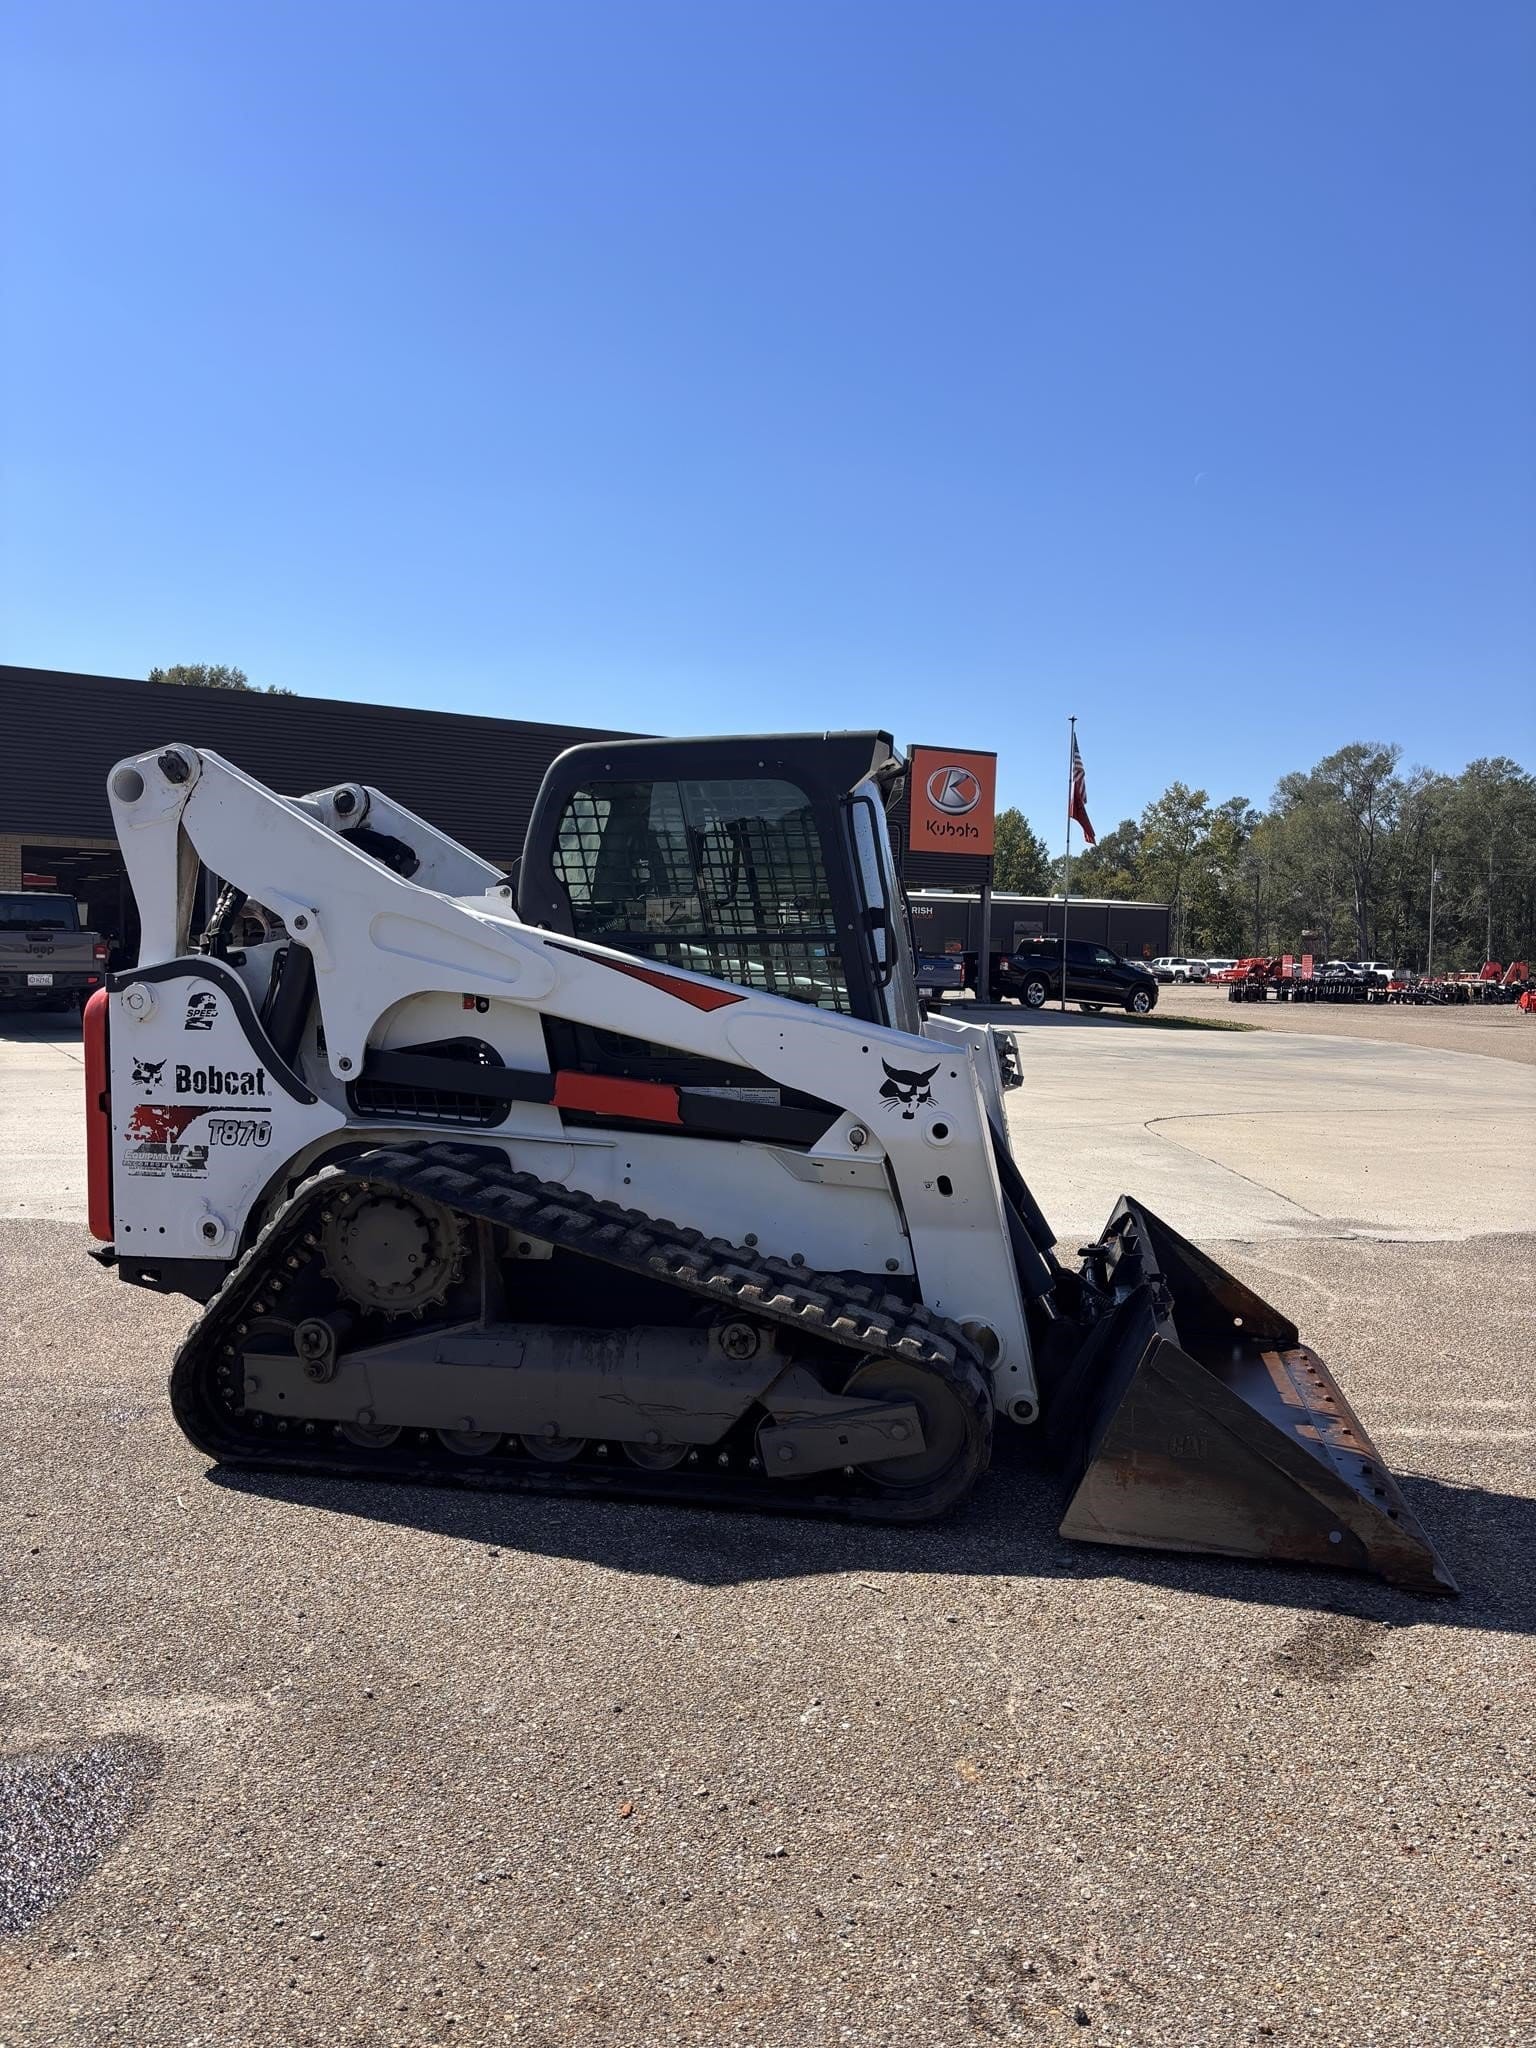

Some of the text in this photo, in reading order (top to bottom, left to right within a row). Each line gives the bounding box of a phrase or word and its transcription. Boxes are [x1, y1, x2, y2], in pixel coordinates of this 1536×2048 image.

[926, 820, 979, 838] Kubota
[24, 944, 55, 956] Jeep
[175, 1064, 266, 1096] Bobcat
[208, 1119, 272, 1147] T870
